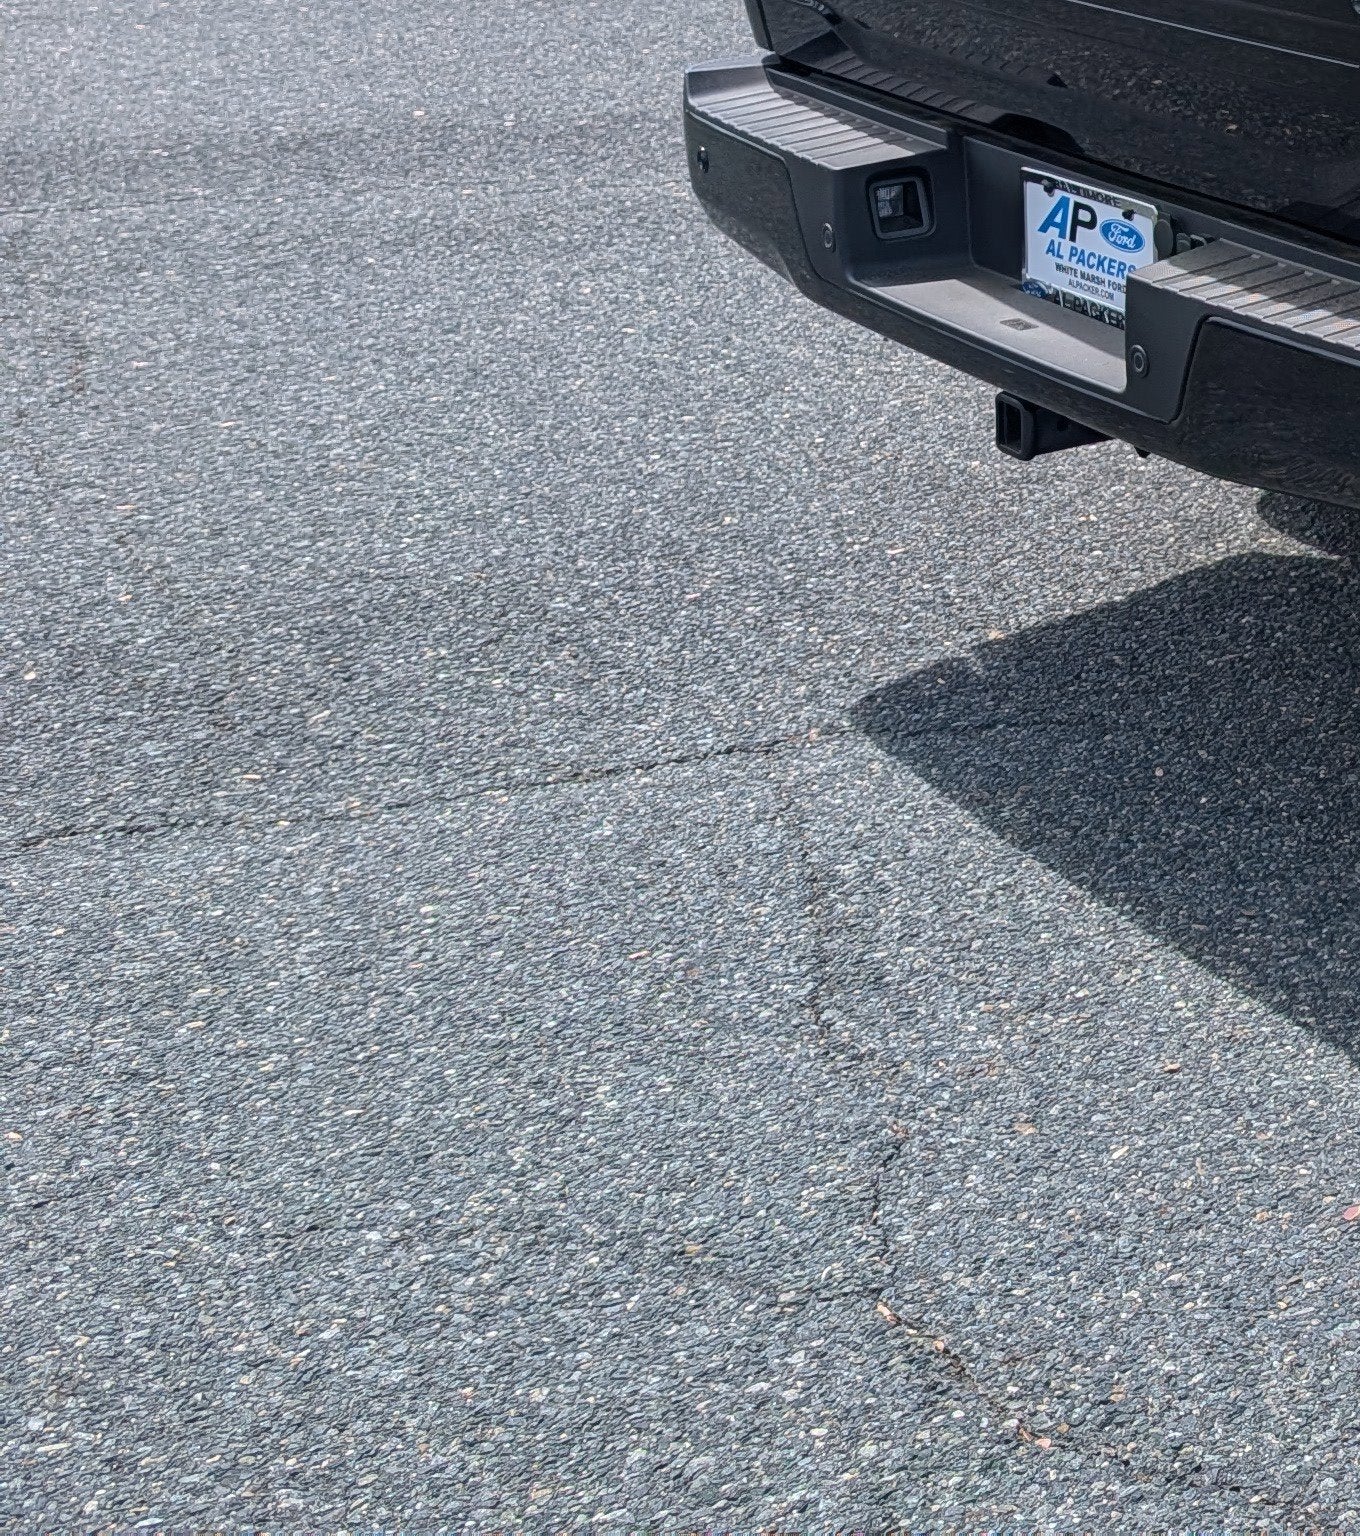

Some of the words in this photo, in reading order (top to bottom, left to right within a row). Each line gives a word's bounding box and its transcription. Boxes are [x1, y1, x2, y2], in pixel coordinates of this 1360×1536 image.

[1037, 195, 1098, 244] AP
[1106, 221, 1138, 251] Ford
[1046, 239, 1064, 260] AL
[1055, 262, 1079, 278] WHITE
[1080, 270, 1106, 288] MARSH
[1068, 279, 1115, 301] ALPACKER.COM
